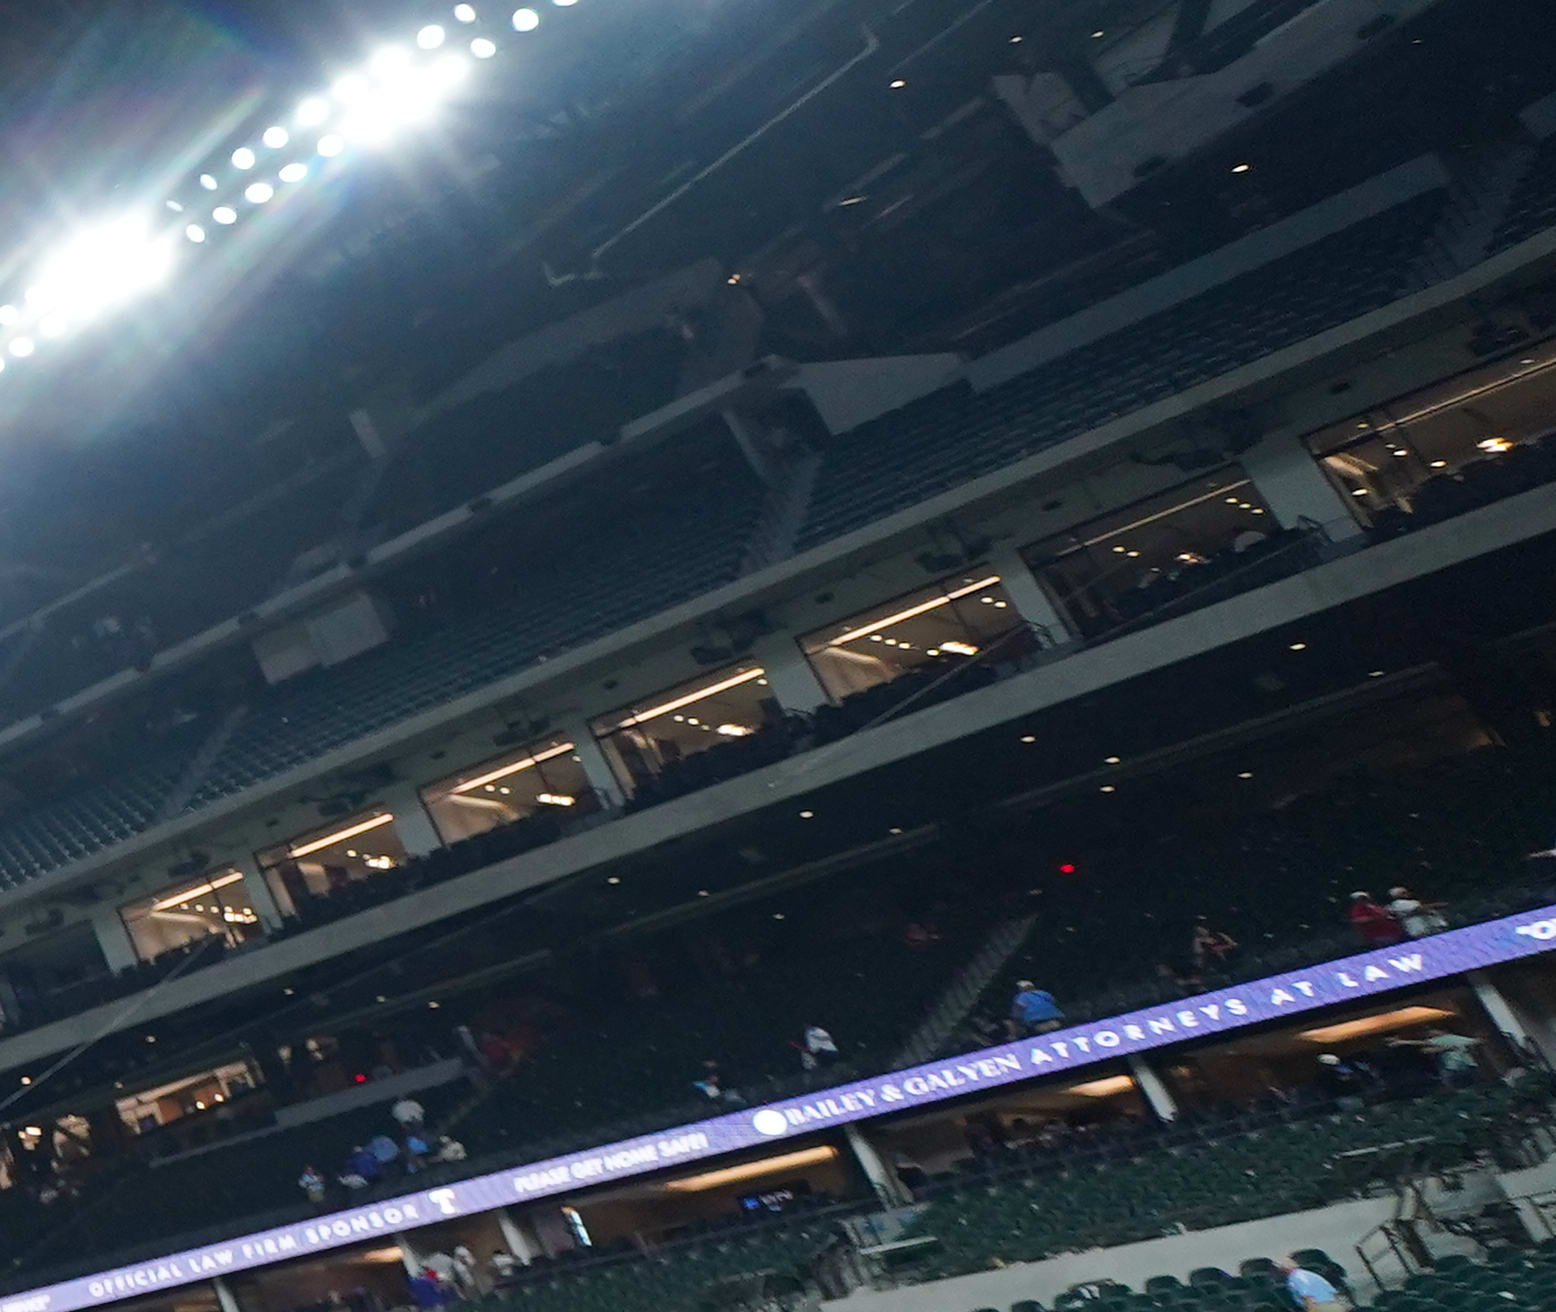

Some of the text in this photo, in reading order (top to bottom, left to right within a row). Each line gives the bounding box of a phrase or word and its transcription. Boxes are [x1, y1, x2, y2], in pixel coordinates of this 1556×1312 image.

[785, 952, 1424, 1127] BAILEY & GALYEN ATTORNEYS AT LAW
[89, 1263, 183, 1298] OFFICIAL
[187, 1250, 234, 1275] LAW
[242, 1233, 295, 1260] FIRM
[305, 1203, 419, 1245] SPONSOR
